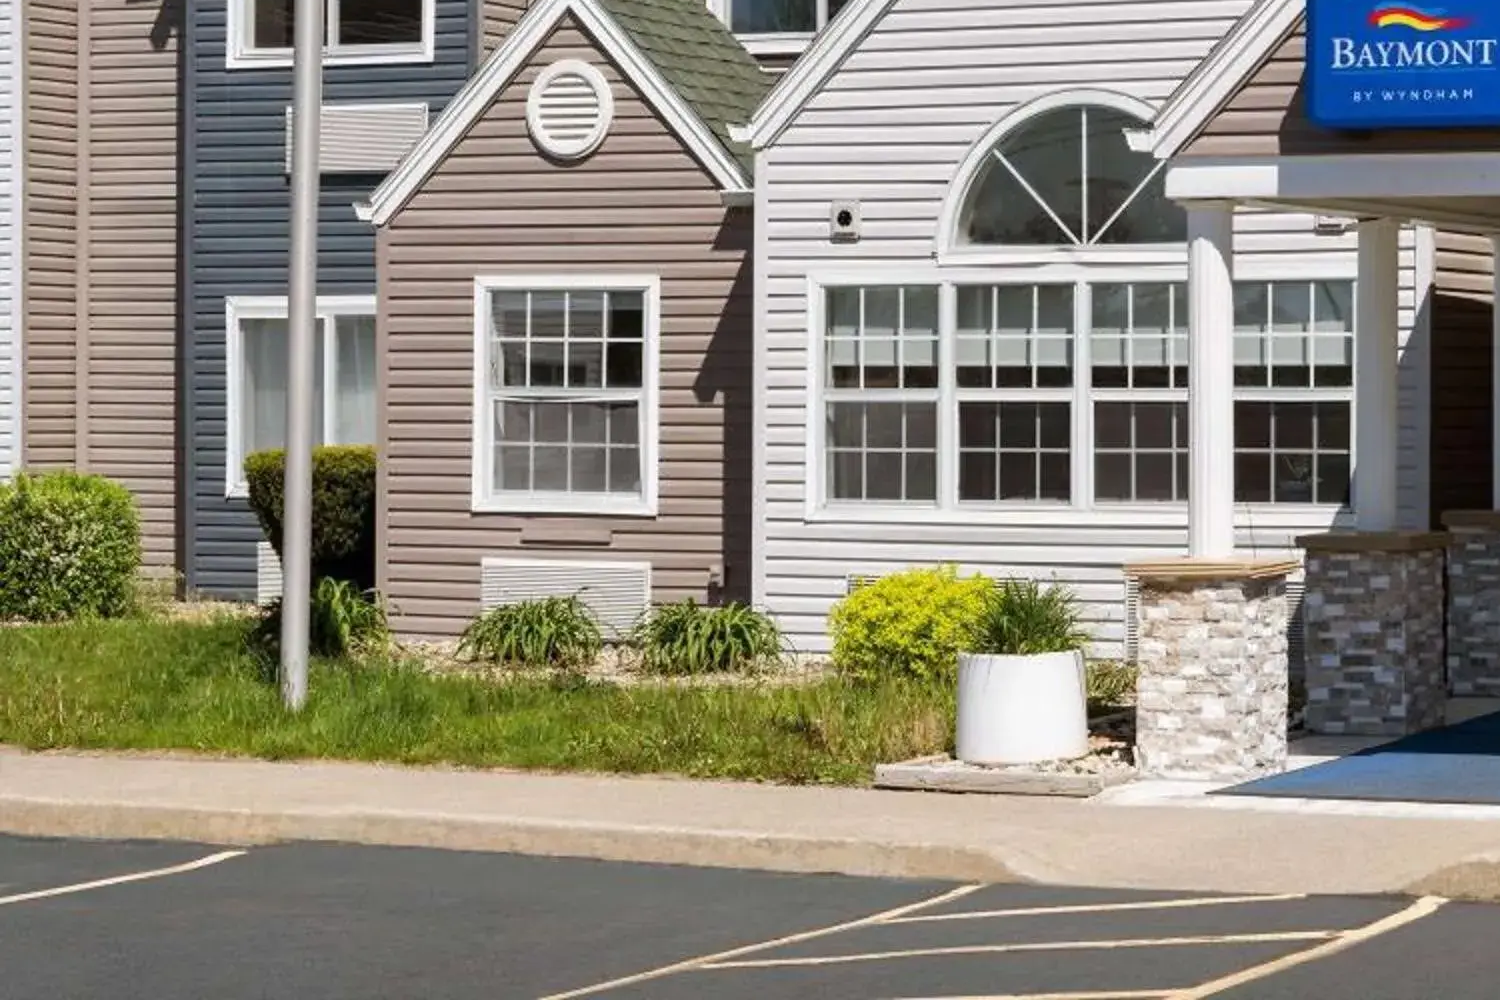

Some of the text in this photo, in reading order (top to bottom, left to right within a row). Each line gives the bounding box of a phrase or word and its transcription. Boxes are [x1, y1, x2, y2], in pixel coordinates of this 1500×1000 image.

[1330, 37, 1497, 69] BAYMONT
[1352, 88, 1474, 102] BY WYNDHAM
